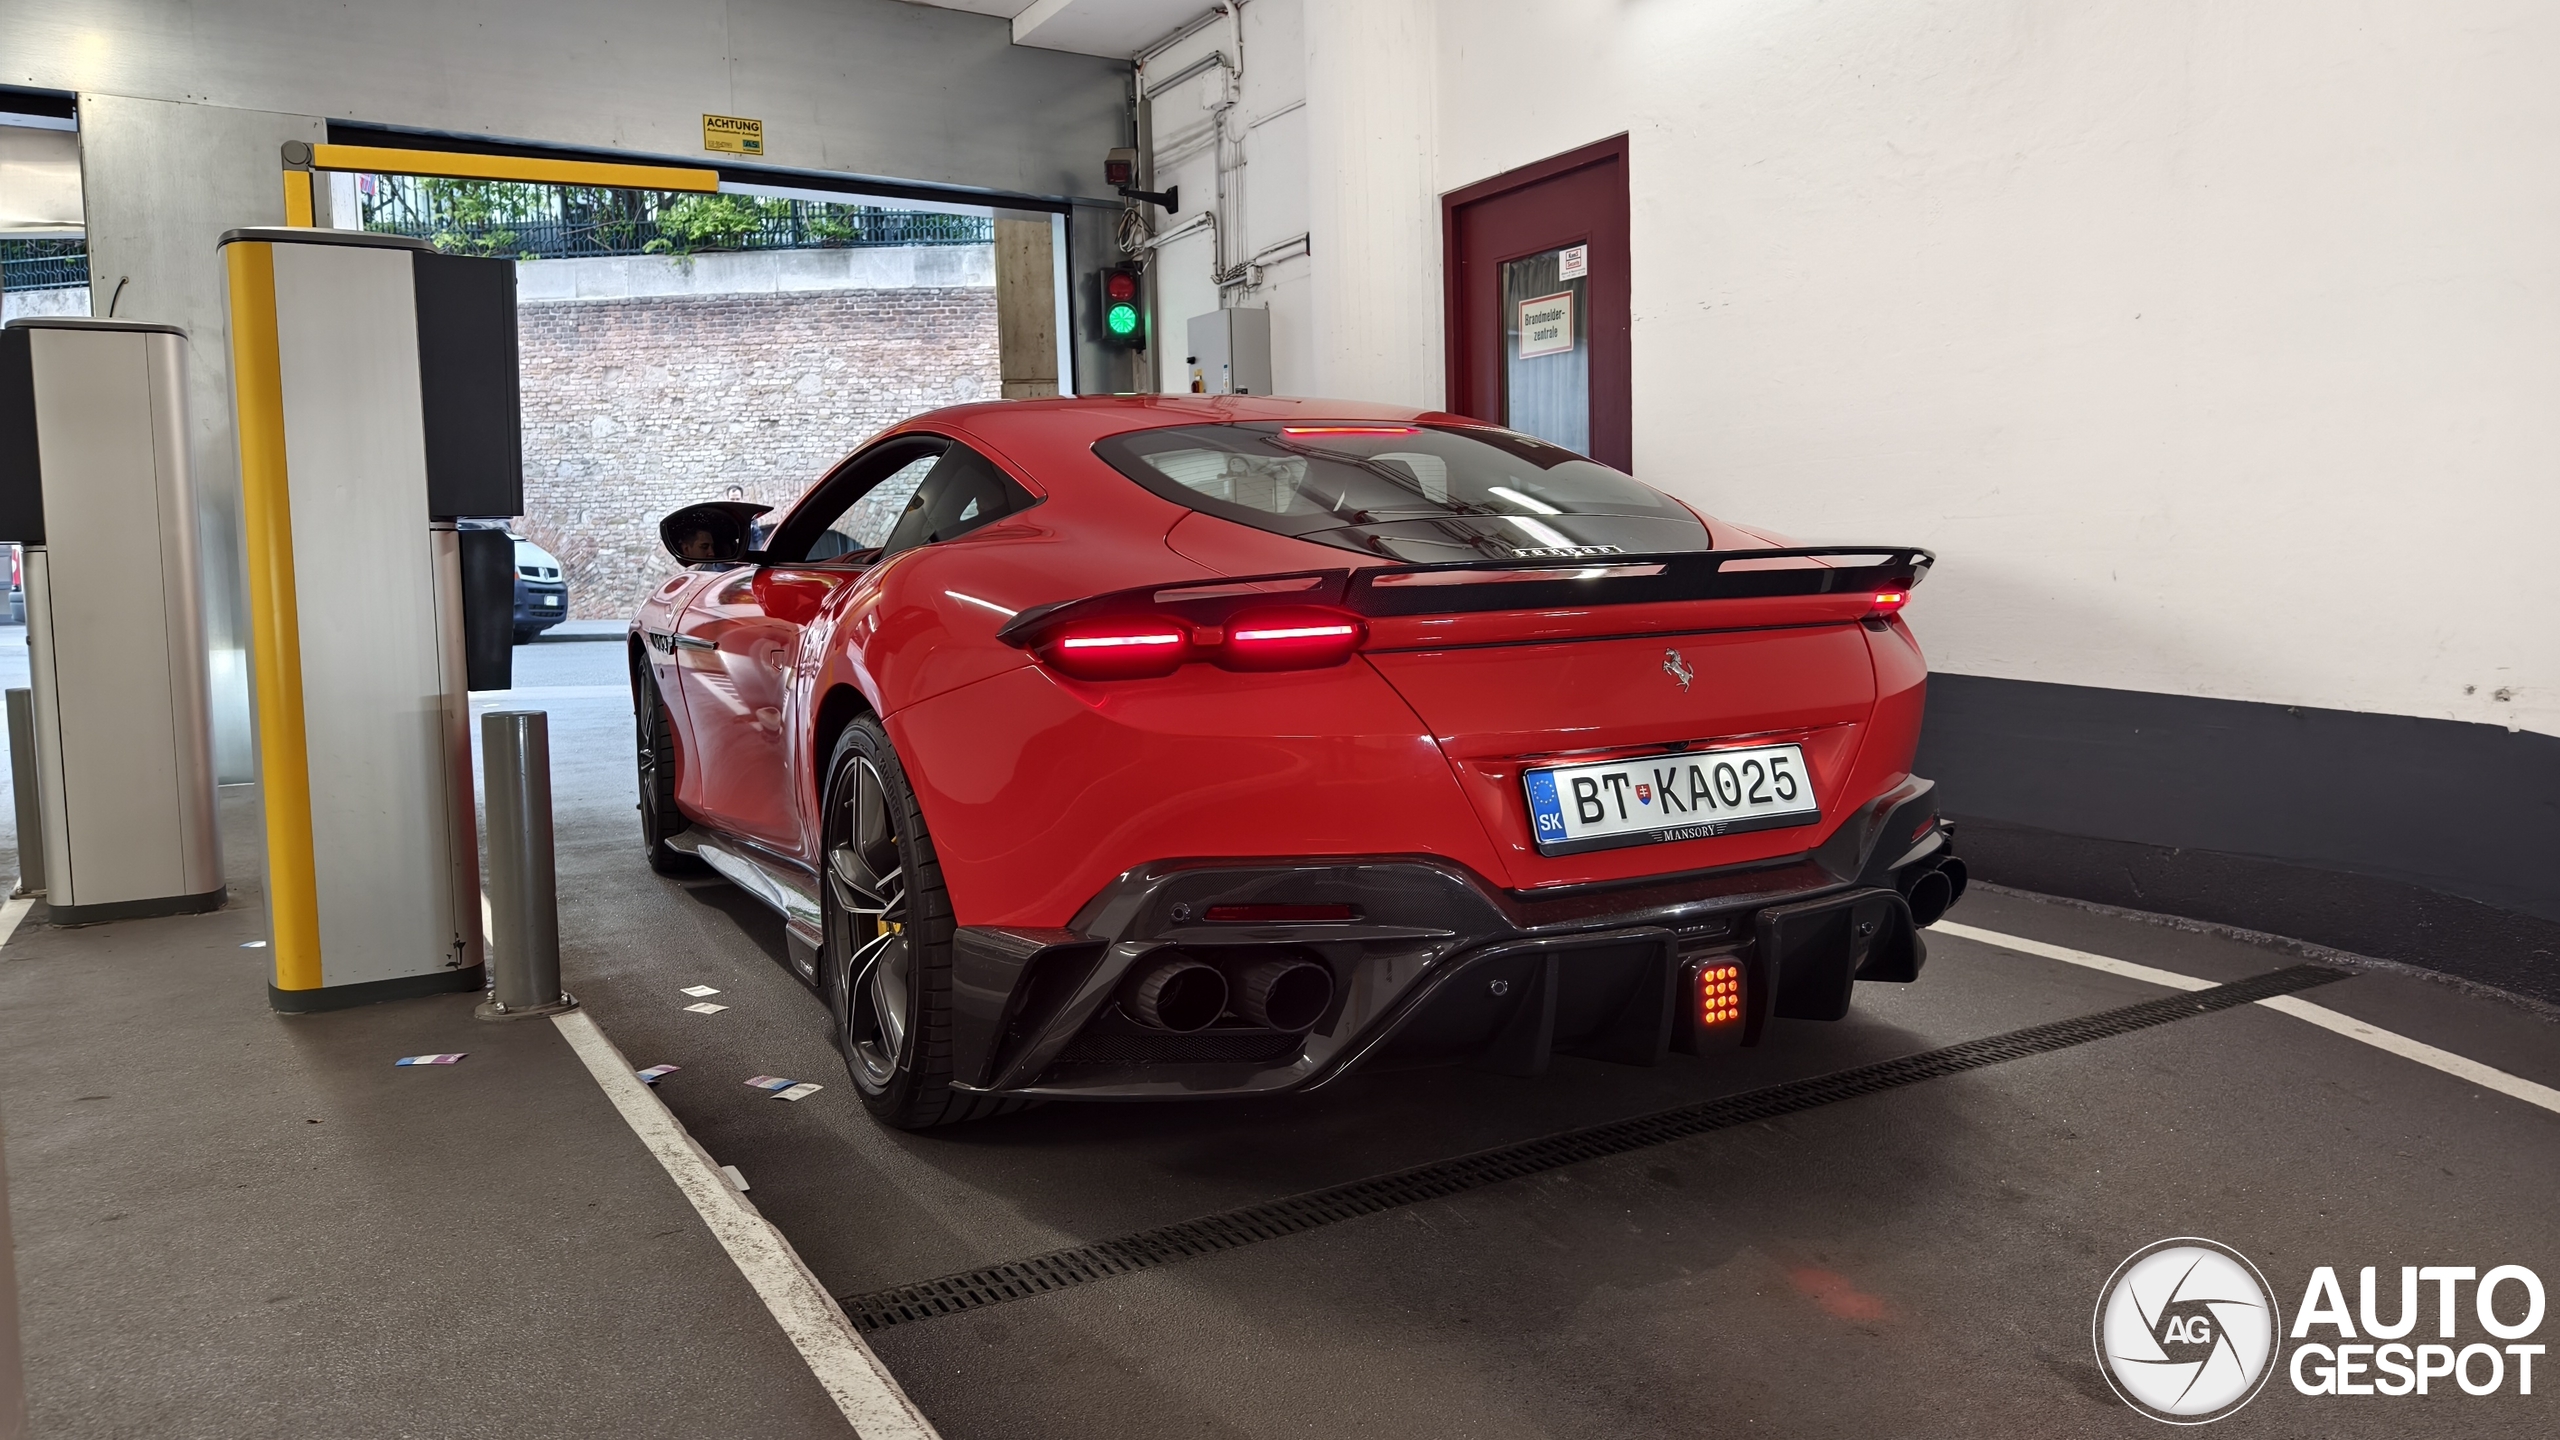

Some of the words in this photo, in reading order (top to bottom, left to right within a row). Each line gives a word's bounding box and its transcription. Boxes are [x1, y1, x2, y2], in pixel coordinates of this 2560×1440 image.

[707, 118, 759, 131] ACHTUNG
[1525, 308, 1565, 326] Brandmelder-
[1534, 326, 1558, 341] zentrale
[1571, 772, 1630, 824] BT
[1653, 756, 1797, 814] KA025
[1539, 813, 1563, 831] SK
[1663, 824, 1716, 842] MANSORY
